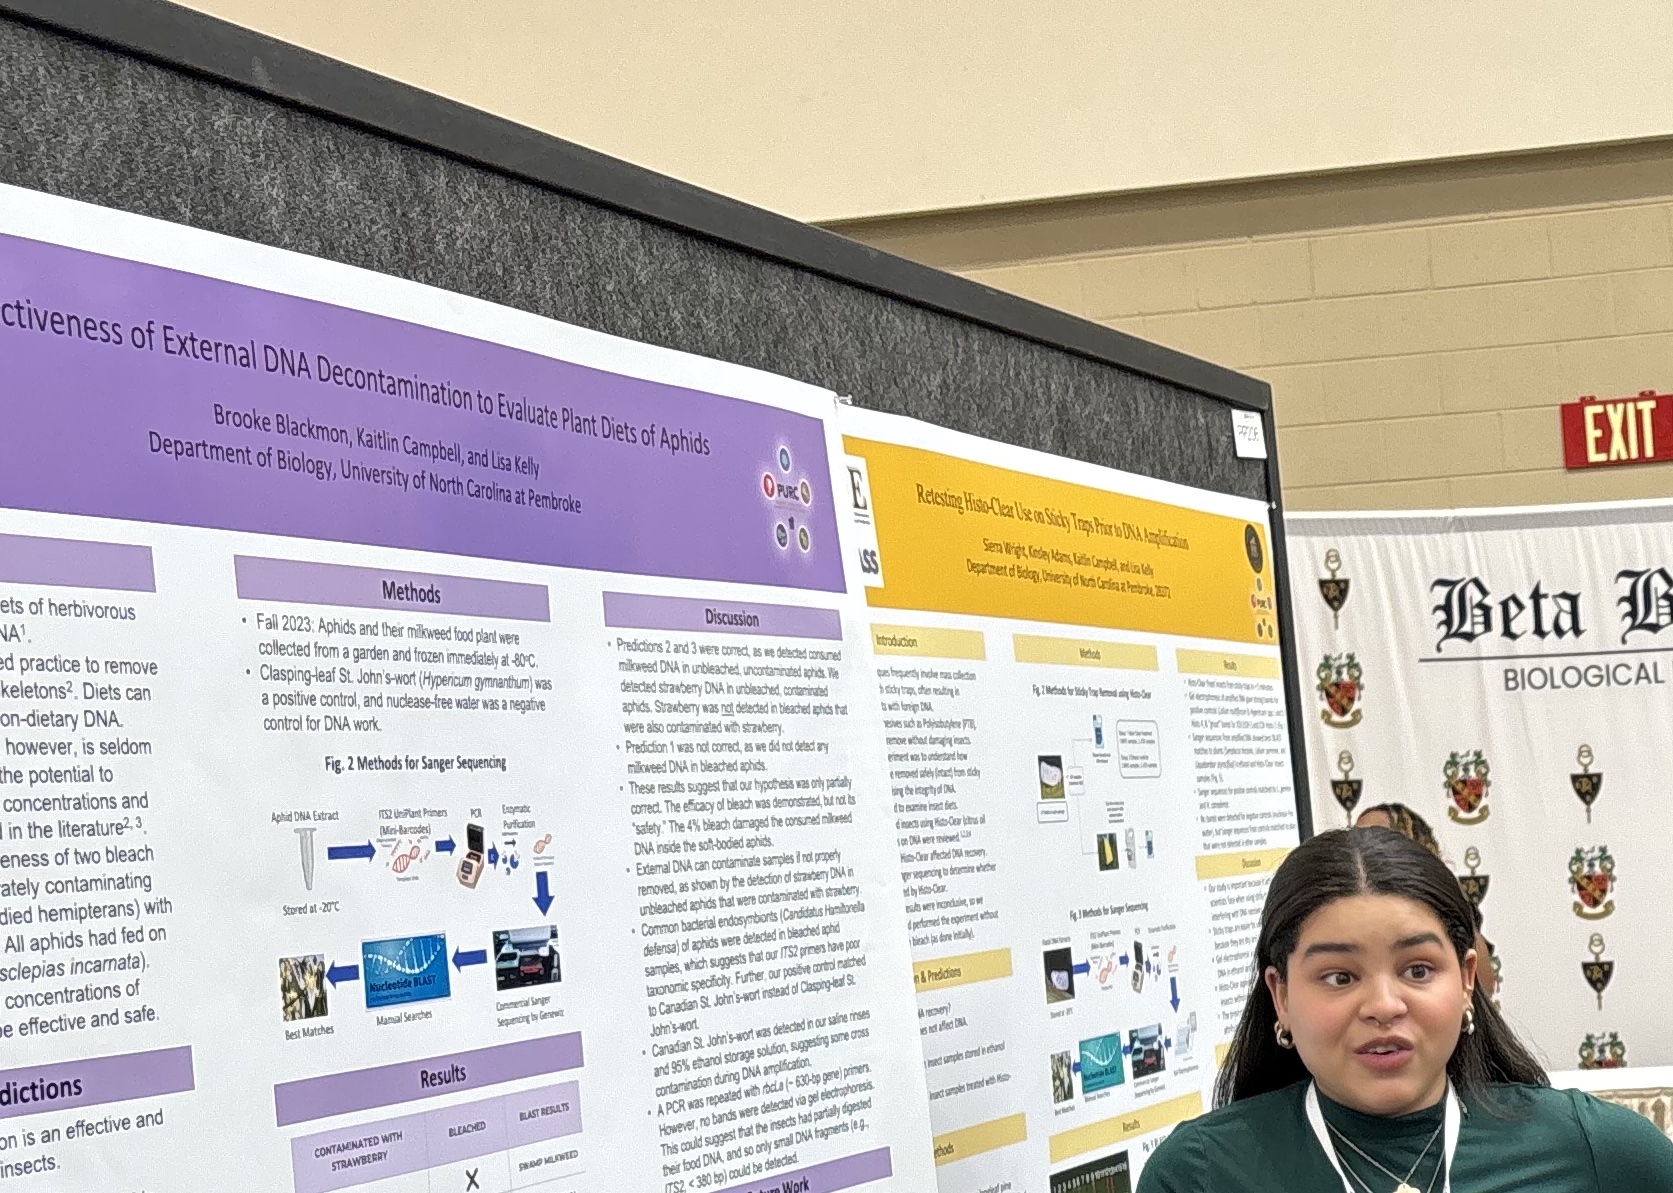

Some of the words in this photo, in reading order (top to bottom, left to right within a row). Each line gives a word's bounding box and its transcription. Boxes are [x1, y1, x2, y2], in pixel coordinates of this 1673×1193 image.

[1, 298, 123, 345] ctiveness
[130, 320, 155, 351] of
[162, 324, 257, 370] External
[263, 344, 312, 380] DNA
[316, 357, 473, 412] Decontamination
[476, 389, 494, 415] to
[497, 392, 558, 429] Evaluate
[561, 407, 598, 438] Plant
[601, 415, 638, 444] Diets
[640, 423, 656, 447] of
[659, 427, 711, 456] Aphids
[213, 403, 272, 433] Brooke
[275, 413, 353, 449] Blackmon,
[356, 427, 400, 453] Kaitlin
[402, 435, 465, 467] Campbell,
[467, 448, 489, 468] and
[491, 449, 512, 472] Lisa
[514, 454, 540, 481] Kelly
[1584, 399, 1657, 463] EXIT
[148, 430, 253, 466] Department
[256, 446, 273, 468] of
[276, 449, 337, 482] Biology,
[340, 458, 410, 493] University
[412, 469, 427, 490] of
[429, 471, 464, 497] North
[466, 478, 512, 503] Carolina
[514, 488, 527, 506] at
[528, 488, 582, 514] Pembroke
[777, 484, 799, 501] PURC
[847, 466, 867, 510] E
[916, 483, 964, 515] Retesting
[963, 491, 1015, 519] Histo-Clear
[1014, 501, 1033, 522] Use
[1034, 509, 1045, 524] on
[1045, 507, 1070, 533] Sticky
[1070, 512, 1094, 537] Traps
[1093, 516, 1113, 537] Prior
[1122, 521, 1143, 542] DNA
[382, 579, 441, 604] Methods
[0, 596, 25, 615] ets
[28, 597, 44, 616] of
[47, 597, 137, 621] herbivorous
[705, 607, 760, 628] Discussion
[1430, 576, 1585, 653] Beta
[256, 612, 279, 631] Fall
[281, 614, 315, 633] 2023:
[317, 616, 357, 638] Aphids
[359, 620, 379, 637] and
[381, 621, 405, 638] their
[407, 623, 452, 641] milkweed
[453, 625, 474, 643] food
[475, 628, 498, 646] plant
[498, 632, 520, 646] were
[19, 654, 81, 676] practice
[84, 655, 100, 674] to
[104, 660, 158, 676] remove
[1503, 661, 1666, 692] BIOLOGICAL
[82, 681, 122, 701] Diets
[125, 687, 152, 702] can
[0, 709, 79, 733] on-dietary
[83, 709, 124, 728] DNA.
[5, 737, 78, 758] however,
[82, 737, 95, 756] is
[99, 737, 152, 756] seldom
[28, 764, 95, 789] potential
[98, 765, 114, 783] to
[324, 755, 345, 775] Fig.
[347, 755, 355, 771] 2
[356, 754, 403, 771] Methods
[404, 754, 420, 770] for
[421, 755, 455, 774] Sanger
[456, 754, 507, 773] Sequencing
[2, 793, 118, 813] concentrations
[121, 790, 149, 810] and
[0, 852, 50, 869] eness
[54, 847, 70, 866] of
[73, 847, 101, 865] two
[105, 843, 155, 864] bleach
[44, 872, 152, 895] contaminating
[37, 898, 141, 925] hemipterans)
[143, 896, 173, 915] with
[4, 934, 25, 954] All
[29, 930, 84, 956] aphids
[88, 927, 117, 947] had
[120, 924, 145, 944] fed
[148, 927, 167, 942] on
[70, 950, 150, 976] incarnata).
[4, 983, 122, 1010] concentrations
[125, 977, 141, 997] of
[18, 1014, 87, 1037] effective
[90, 1007, 120, 1028] and
[124, 1004, 160, 1024] safe.
[420, 1063, 467, 1089] Results
[0, 1077, 83, 1107] dictions
[448, 1120, 487, 1138] BLEACHED
[314, 1135, 380, 1159] CONTAMINATED
[380, 1130, 403, 1144] WITH
[331, 1150, 388, 1172] STRAWBERRY
